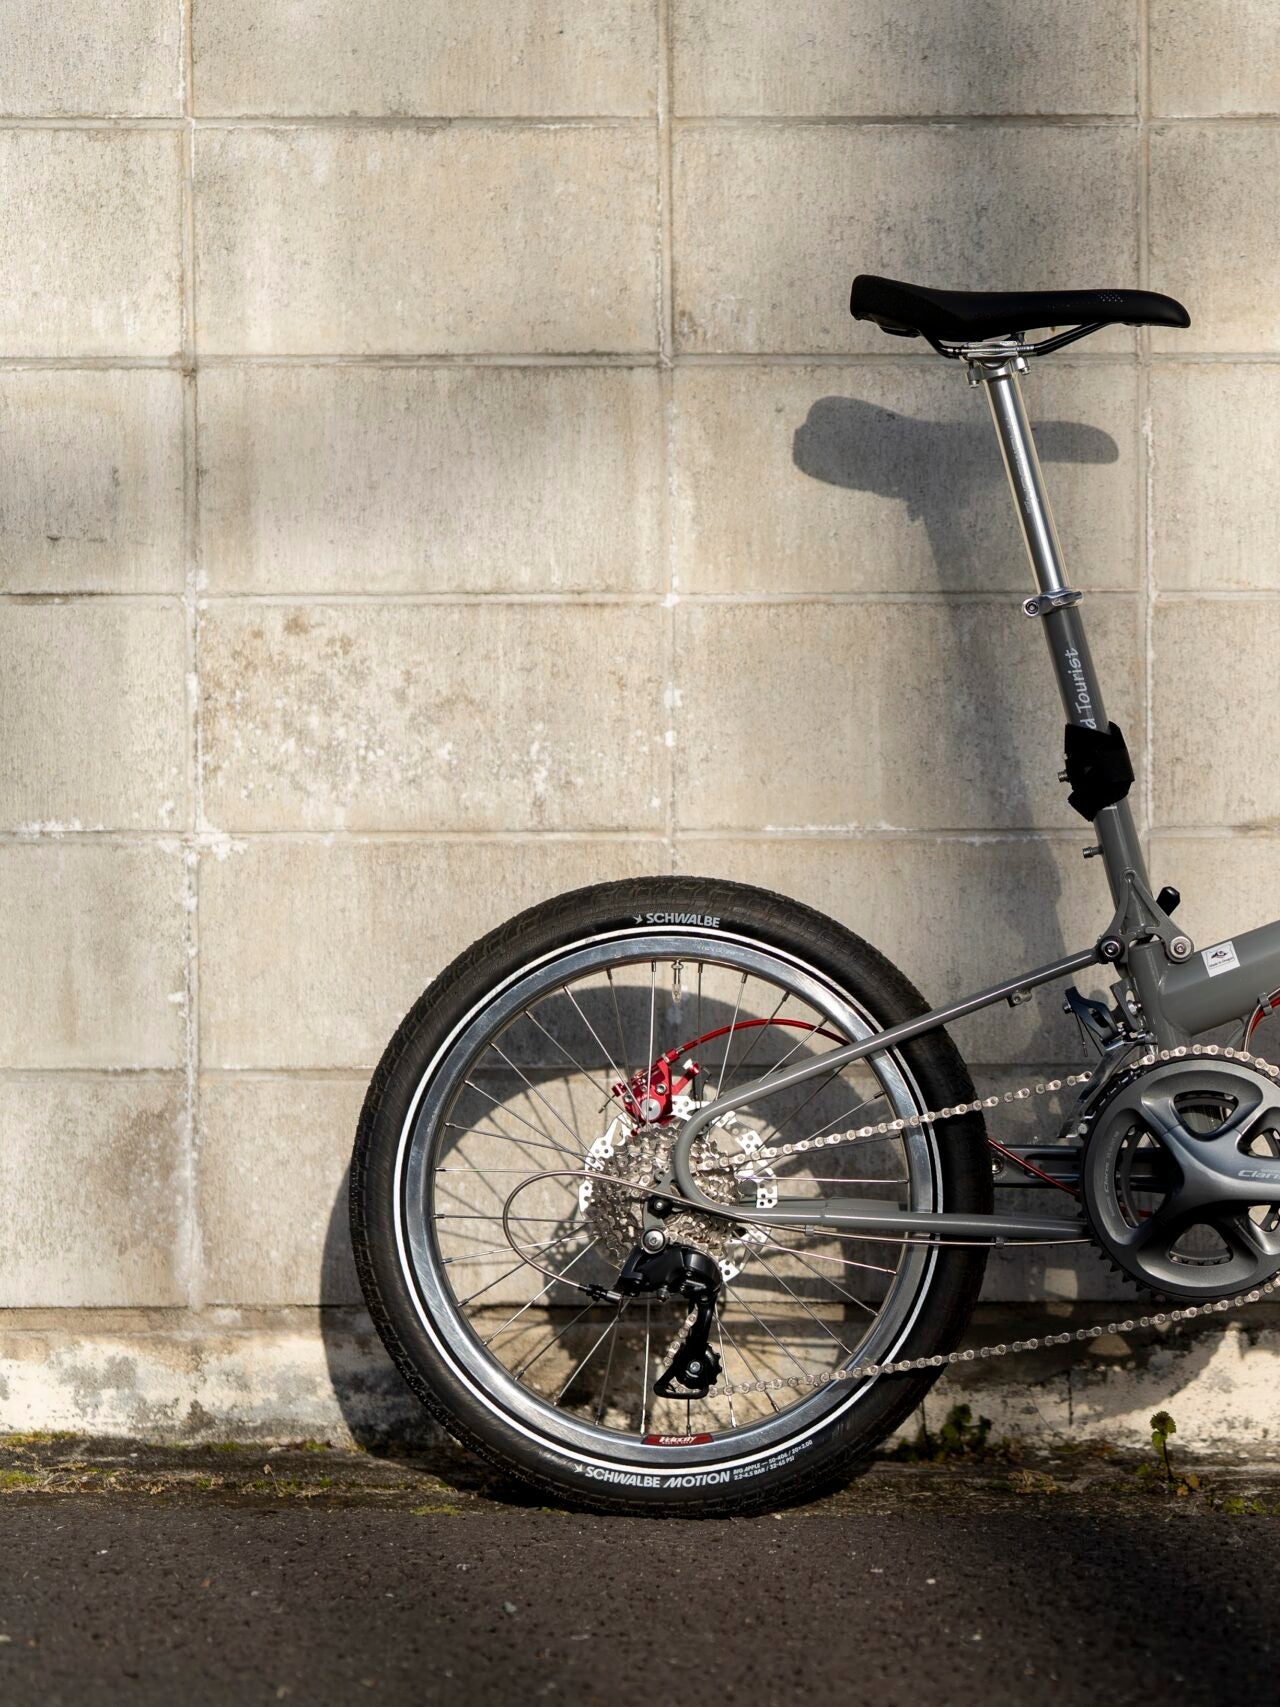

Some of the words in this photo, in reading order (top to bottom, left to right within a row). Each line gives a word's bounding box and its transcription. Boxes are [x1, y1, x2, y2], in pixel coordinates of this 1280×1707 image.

[1065, 647, 1092, 714] Tourist
[646, 912, 721, 928] SCHWALBE
[585, 1467, 661, 1488] SCHWALBE
[663, 1470, 730, 1488] MOTION
